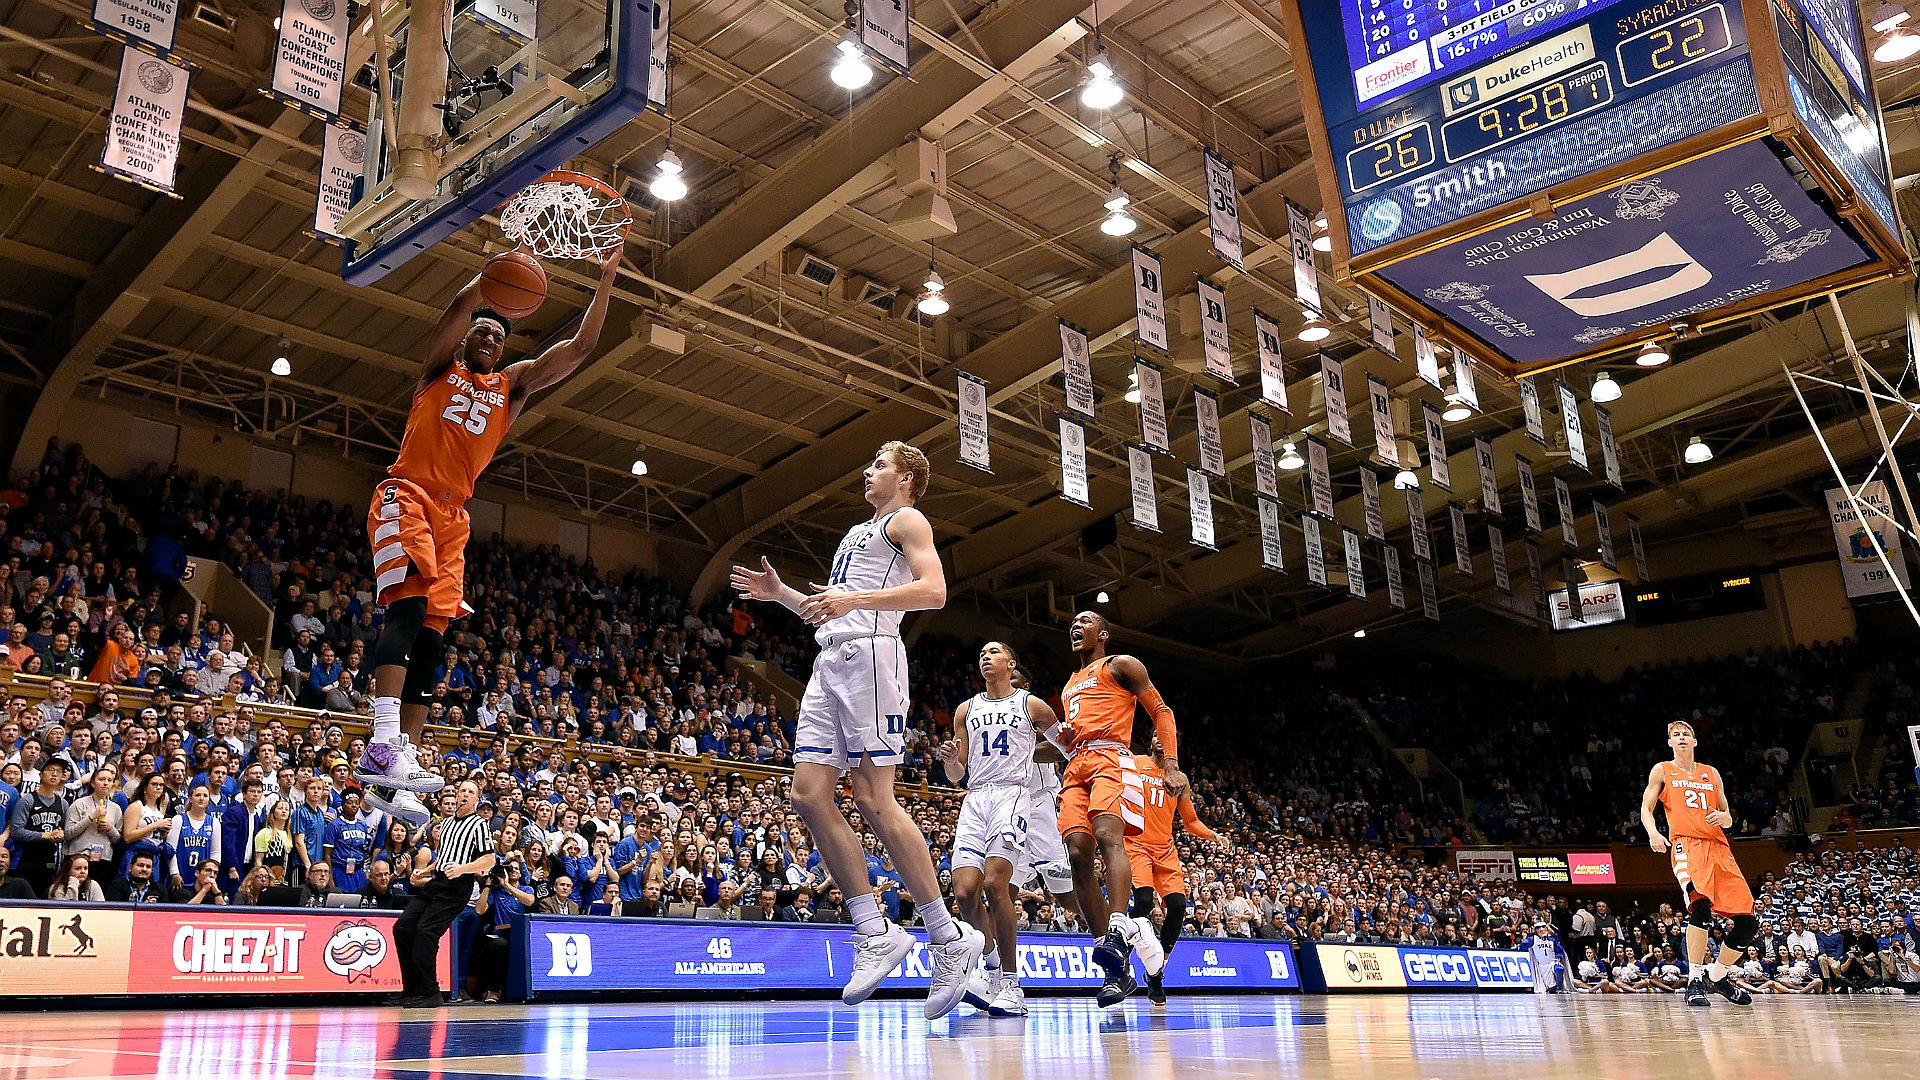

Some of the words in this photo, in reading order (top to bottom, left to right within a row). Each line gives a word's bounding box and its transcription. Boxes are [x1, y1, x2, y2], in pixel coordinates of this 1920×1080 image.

[120, 14, 151, 33] 1958
[140, 7, 164, 23] SEASON
[496, 4, 520, 24] 1978
[1370, 10, 1386, 24] 14
[1448, 22, 1476, 41] 3-PT
[1480, 4, 1516, 26] FIELD
[292, 20, 336, 46] ATLANTIC
[1372, 26, 1390, 42] 20
[1406, 13, 1416, 26] 2
[1376, 41, 1391, 56] 41
[1408, 29, 1418, 40] 0
[1442, 14, 1448, 26] 1
[1446, 29, 1498, 60] 16.7%
[1522, 1, 1565, 28] 60%
[298, 34, 329, 54] COAST
[1649, 17, 1706, 70] 22
[281, 38, 342, 72] CONFERENCE
[650, 56, 666, 72] OUR
[1484, 40, 1585, 90] DukeHealth
[282, 50, 338, 82] CHAMPIONS
[1364, 58, 1418, 88] Frontier
[290, 68, 328, 88] TOURNAMENT
[1568, 68, 1604, 90] PERIOD
[294, 82, 321, 100] 1960
[1590, 84, 1598, 100] 1
[128, 95, 172, 120] ATLANTIC
[134, 108, 163, 127] COAST
[1479, 82, 1567, 138] 9:28
[114, 115, 176, 144] CONFERENCE
[1354, 106, 1414, 144] DUKE
[118, 139, 144, 152] REGULAR
[1414, 158, 1506, 208] Smith
[1509, 76, 1736, 171] Orthodontics
[126, 156, 154, 173] 2000
[1374, 132, 1419, 178] 26
[330, 166, 356, 180] ATLAN
[322, 184, 350, 199] CONFE
[336, 178, 352, 190] COA
[326, 206, 347, 217] REGULA
[1214, 188, 1236, 218] 35
[1724, 189, 1744, 215] Duke
[1542, 218, 1560, 230] &
[1562, 206, 1594, 223] Inn
[1506, 226, 1545, 246] Golf
[1511, 216, 1612, 254] Washington
[1294, 238, 1312, 267] 32
[1464, 239, 1504, 260] Club
[1466, 247, 1510, 268] Duke
[1144, 298, 1158, 310] NCAA
[1630, 296, 1722, 328] Washington
[1138, 308, 1153, 321] FINAL
[446, 372, 506, 408] SYRACUSE
[441, 392, 492, 436] 25
[1836, 494, 1882, 511] NATONAL
[832, 551, 853, 586] 41
[1722, 576, 1751, 588] SYRACUSE
[1556, 593, 1618, 611] SARP
[1636, 592, 1659, 602] DUKE
[1069, 694, 1080, 720] 5
[970, 712, 1022, 732] DUKE
[981, 730, 1010, 757] 14
[1672, 780, 1714, 792] SYRACUSE
[1150, 787, 1164, 808] 11
[1684, 790, 1708, 810] 21
[32, 812, 62, 826] DUKE
[183, 837, 208, 849] DUKE
[188, 851, 200, 866] 0
[706, 938, 732, 958] 46
[1359, 952, 1377, 960] BUFFALO
[674, 962, 766, 975] ALL-AMERICANS
[1362, 960, 1379, 971] WILD
[1404, 953, 1471, 982] GEICO
[1472, 956, 1534, 983] GEICO
[1365, 971, 1383, 982] WINGS
